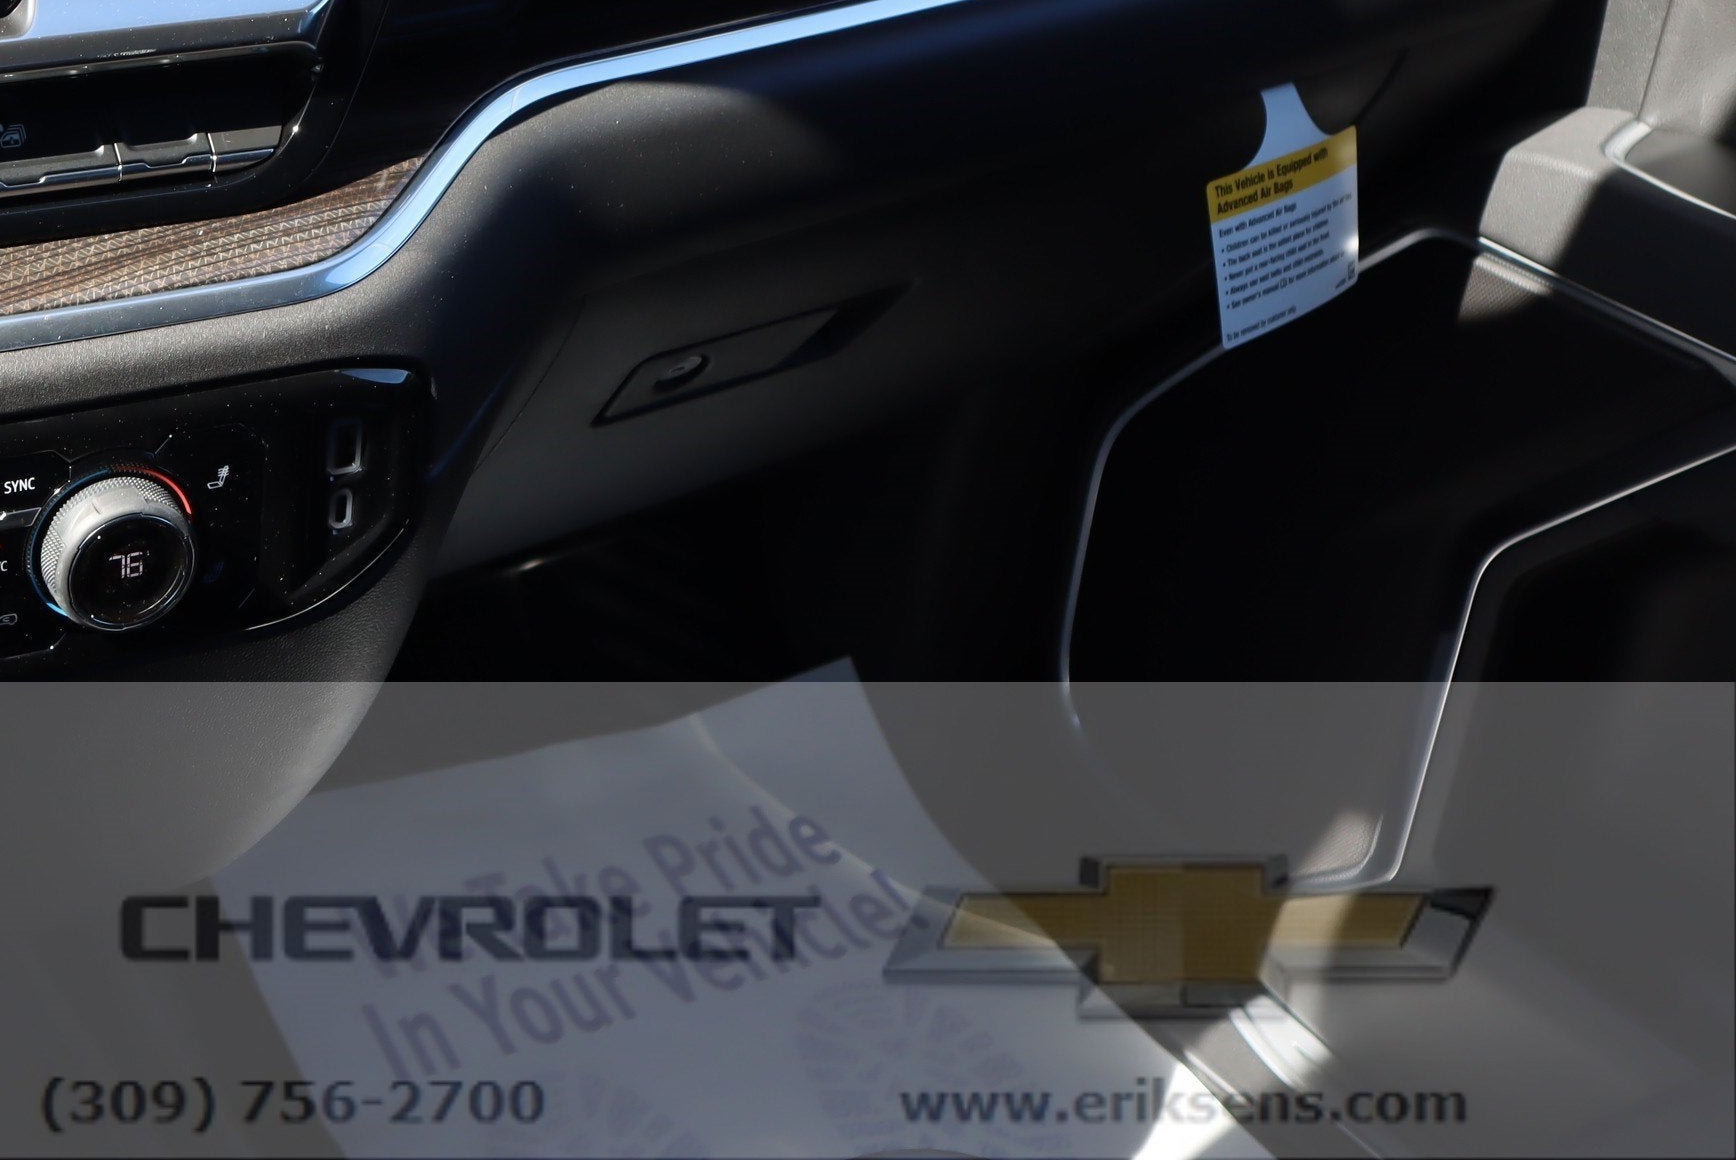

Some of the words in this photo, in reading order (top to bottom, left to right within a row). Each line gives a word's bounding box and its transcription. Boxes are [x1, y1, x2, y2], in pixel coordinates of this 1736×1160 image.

[1215, 184, 1233, 198] This
[1235, 172, 1265, 191] Vehicle
[1268, 169, 1274, 180] is
[1277, 154, 1312, 177] Equipped
[1314, 147, 1328, 162] with
[1218, 190, 1258, 215] Advanced
[1261, 186, 1271, 199] Air
[1274, 179, 1293, 194] Bags
[3, 476, 36, 495] SYNC
[108, 551, 144, 579] 76
[464, 855, 652, 948] Take
[644, 805, 842, 906] Pride
[362, 1002, 463, 1083] In
[448, 960, 637, 1057] Your
[636, 867, 929, 1004] Vehicle!
